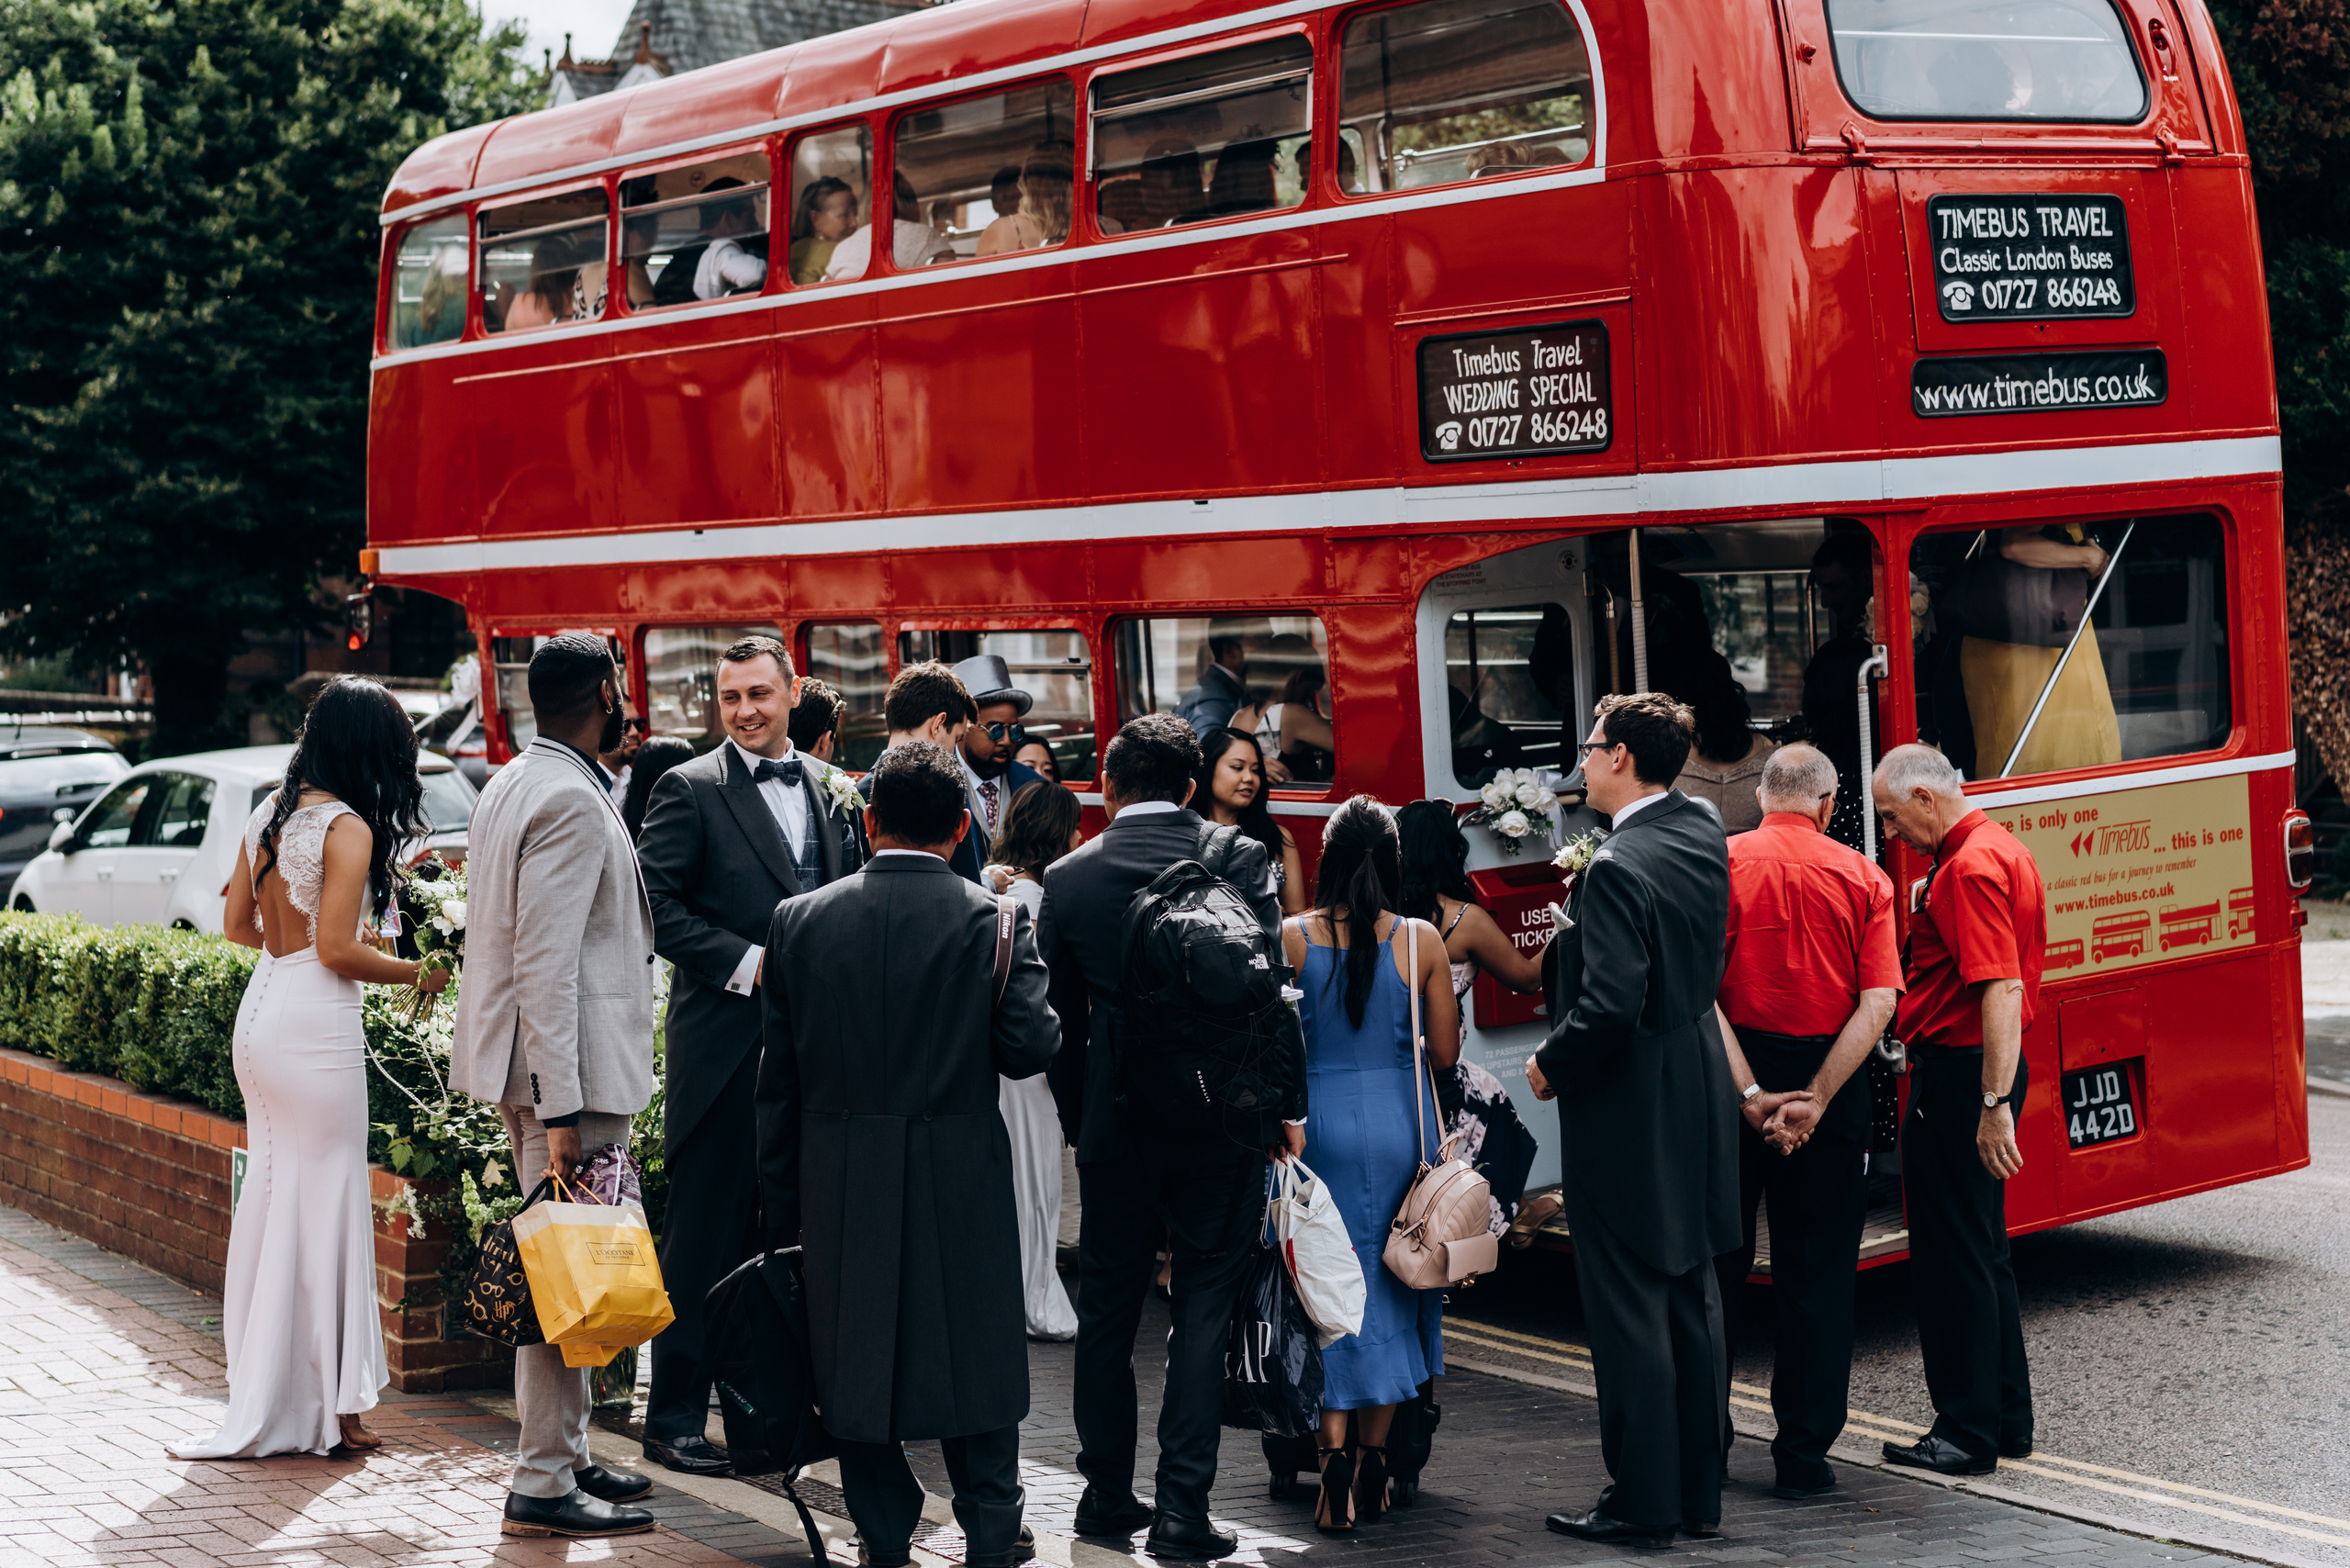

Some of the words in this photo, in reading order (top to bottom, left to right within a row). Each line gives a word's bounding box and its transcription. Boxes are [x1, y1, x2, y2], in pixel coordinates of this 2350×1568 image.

[1937, 207, 2030, 239] TIMEBUS
[2036, 207, 2113, 237] TRAVEL
[1940, 247, 2001, 274] Classic
[2006, 246, 2066, 272] London
[2069, 245, 2113, 270] Buses
[1981, 279, 2038, 310] 01727
[2047, 277, 2121, 308] 866248
[1452, 344, 1521, 378] Timebus
[1530, 335, 1583, 369] Travel
[1443, 378, 1519, 414] WEDDING
[1529, 371, 1597, 408] SPECIAL
[1915, 364, 2156, 409] www.timebus.co.uk
[1468, 414, 1523, 448] 01727
[1530, 408, 1607, 443] 866248
[2020, 813, 2032, 832] is
[2039, 809, 2068, 830] only
[2074, 808, 2098, 823] one
[2171, 831, 2197, 850] this
[2202, 828, 2214, 846] is
[2220, 827, 2244, 843] one
[2047, 881, 2052, 890] a
[2054, 876, 2077, 890] classic
[2080, 872, 2092, 886] red
[2094, 870, 2106, 884] bus
[2107, 868, 2119, 887] for
[2121, 870, 2125, 879] a
[2127, 866, 2154, 883] journey
[2156, 863, 2163, 874] to
[2165, 857, 2197, 873] remember
[2054, 881, 2175, 914] www.timebus.co.uk
[1002, 913, 1011, 939] Nikon
[1511, 927, 1555, 948] TICKE
[1484, 1050, 1494, 1058] 72
[1501, 1069, 1517, 1079] AND
[2073, 1070, 2121, 1108] JJD
[2069, 1103, 2134, 1143] 442D
